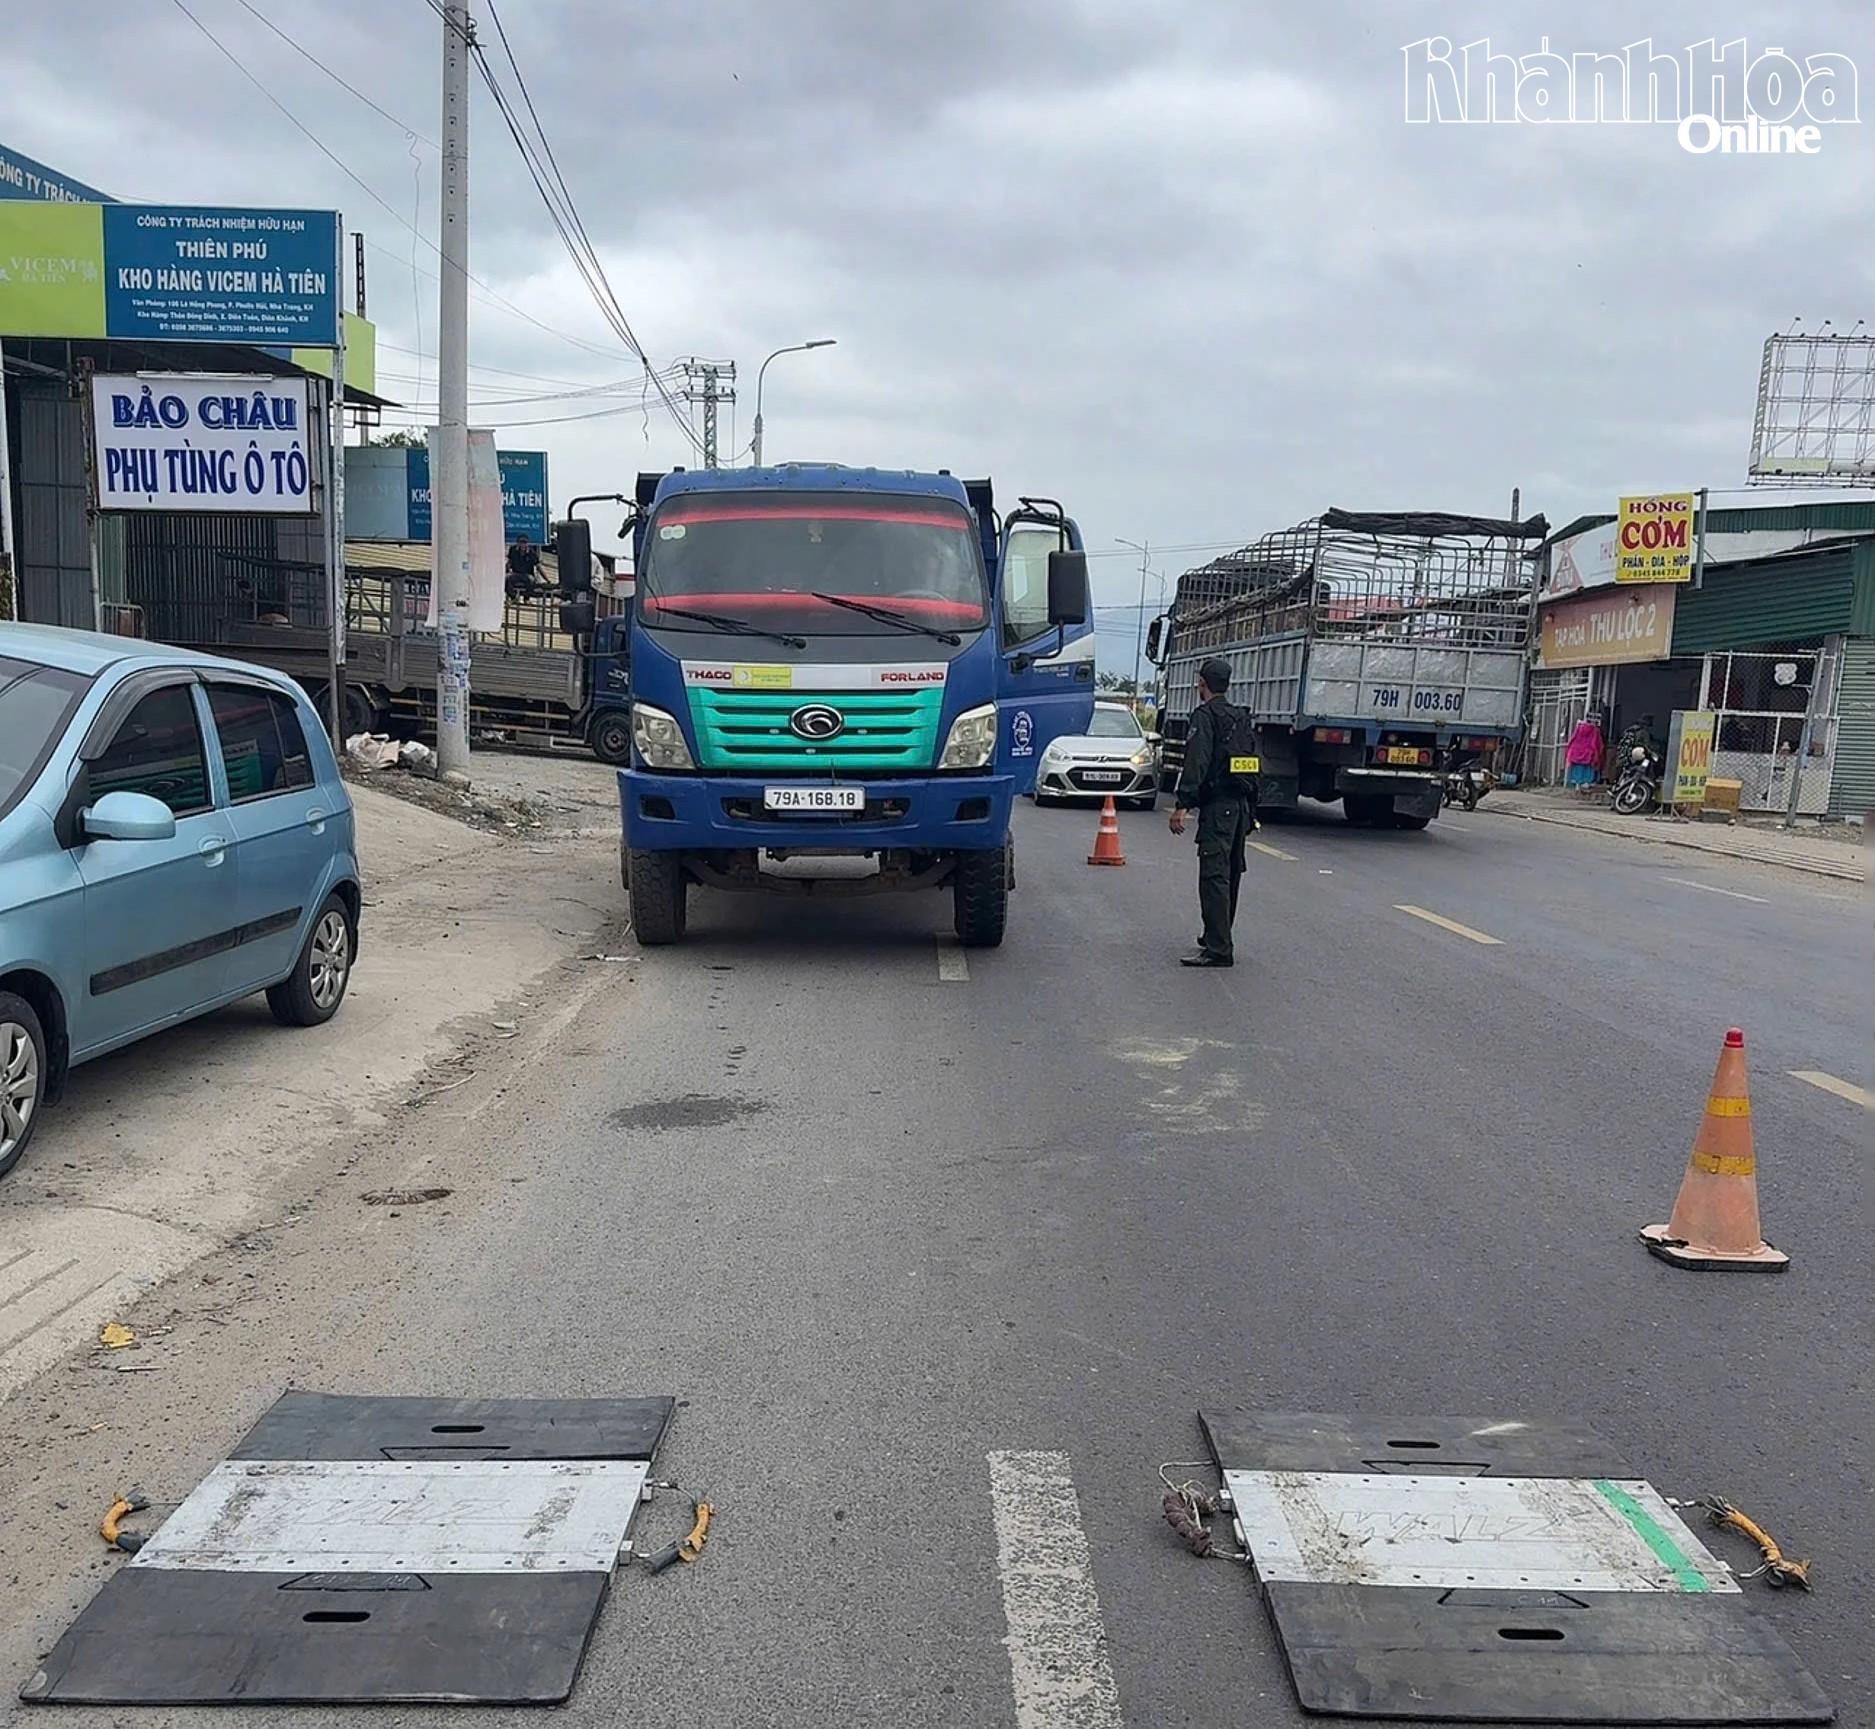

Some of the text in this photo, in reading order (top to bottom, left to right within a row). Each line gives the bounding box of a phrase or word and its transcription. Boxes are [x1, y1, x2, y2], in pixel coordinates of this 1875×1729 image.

[25, 172, 41, 194] TY
[137, 214, 305, 233] CÔNG TY TRÁCH NHIỆM HỮU HẠN
[176, 238, 268, 259] THIÊN PHÚ
[9, 256, 77, 273] VICEM
[118, 263, 326, 295] KHO HÀNG VICEM HÀ TIÊN
[112, 385, 298, 431] BẢO CHÂU
[107, 439, 307, 504] PHỤ TÙNG Ô TÔ
[518, 488, 543, 508] TIÊN
[1621, 514, 1688, 550] CƠM
[1590, 610, 1616, 643] THU
[1646, 603, 1657, 637] 2
[686, 670, 732, 680] THACO
[880, 672, 945, 683] FORLAND
[1373, 689, 1462, 712] 79H 003.60
[773, 791, 856, 806] 79A-168.18
